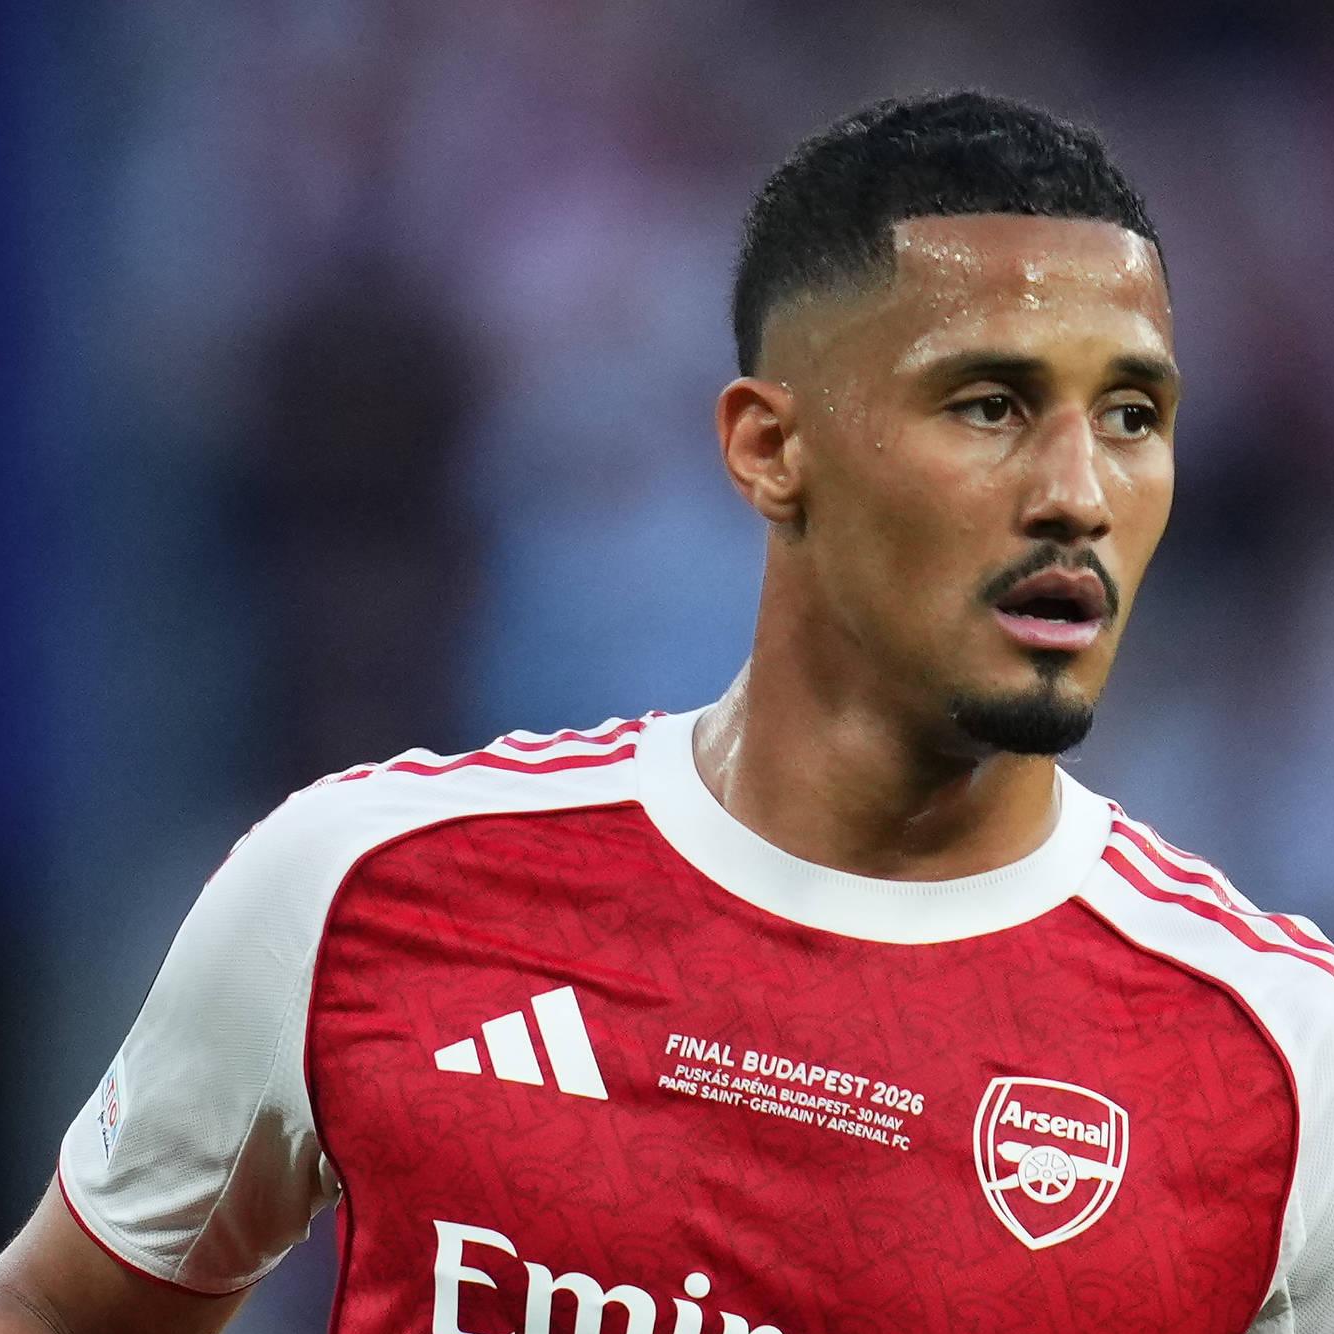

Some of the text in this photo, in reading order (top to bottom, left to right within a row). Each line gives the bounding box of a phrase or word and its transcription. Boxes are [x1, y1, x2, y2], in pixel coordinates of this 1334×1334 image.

[665, 1033, 924, 1115] FINAL BUDAPEST 2026
[674, 1064, 729, 1087] PUSKÁS
[730, 1076, 777, 1098] ARÉNA
[857, 1107, 873, 1123] 30
[873, 1112, 903, 1131] MAY
[658, 1075, 910, 1151] PARIS SAINT-GERMAIN V ARSENAL FC
[999, 1100, 1109, 1149] Arsenal
